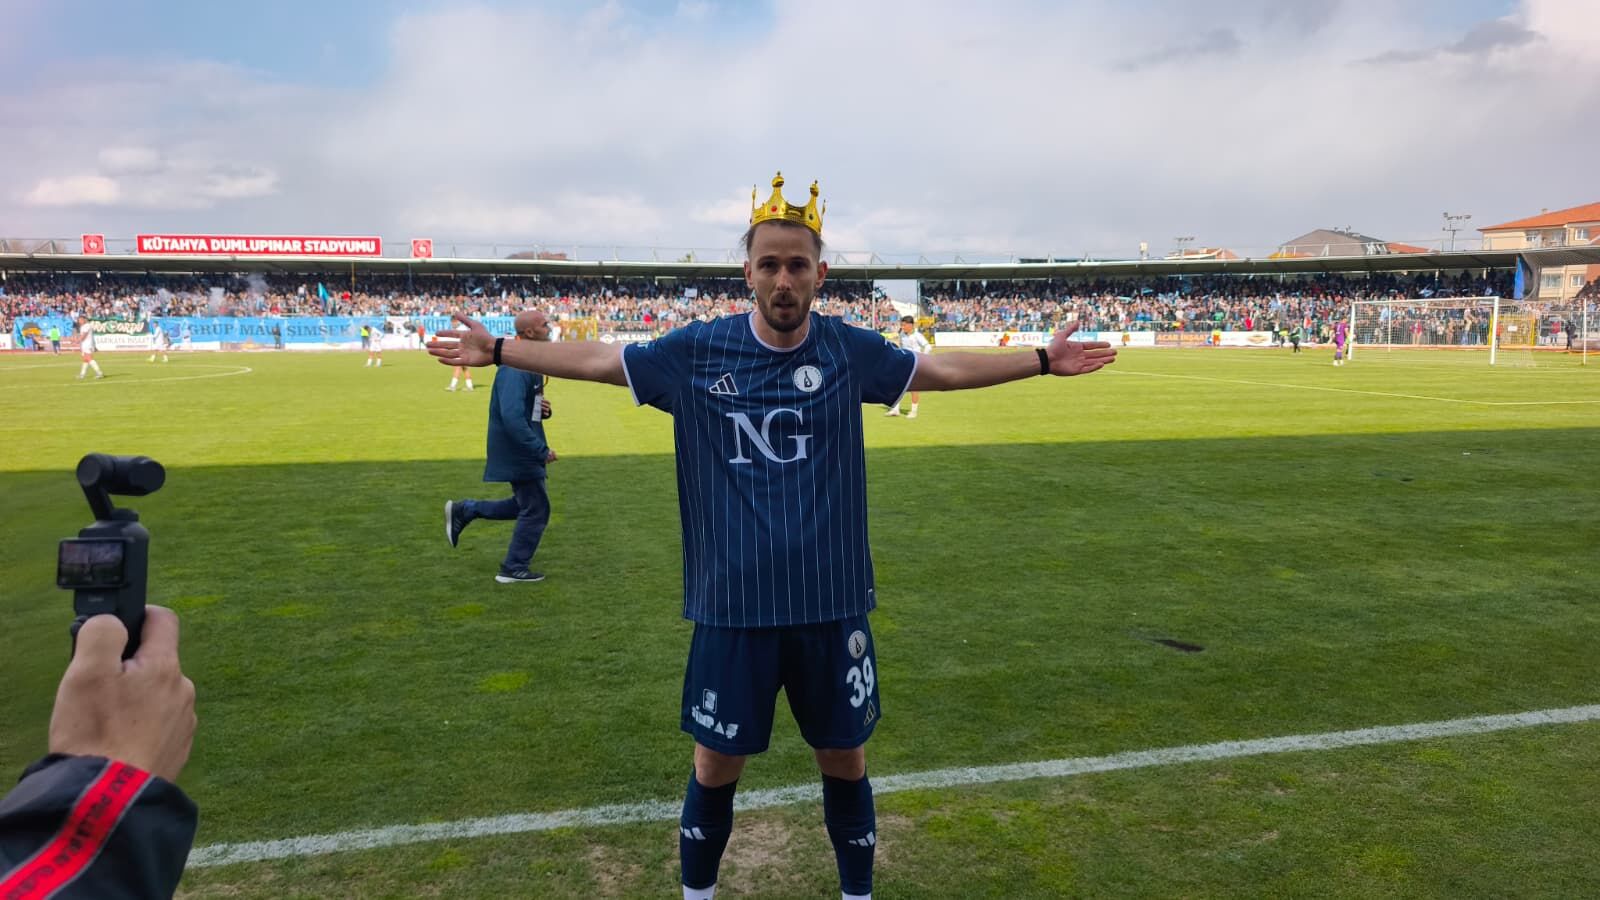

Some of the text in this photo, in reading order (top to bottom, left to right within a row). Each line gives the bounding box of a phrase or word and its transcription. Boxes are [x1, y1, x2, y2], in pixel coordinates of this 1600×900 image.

[143, 236, 376, 253] KÜTAHYA DUMLUPINAR STADYUMU
[189, 323, 234, 336] GRUP
[725, 408, 813, 464] NG
[846, 655, 875, 708] 39
